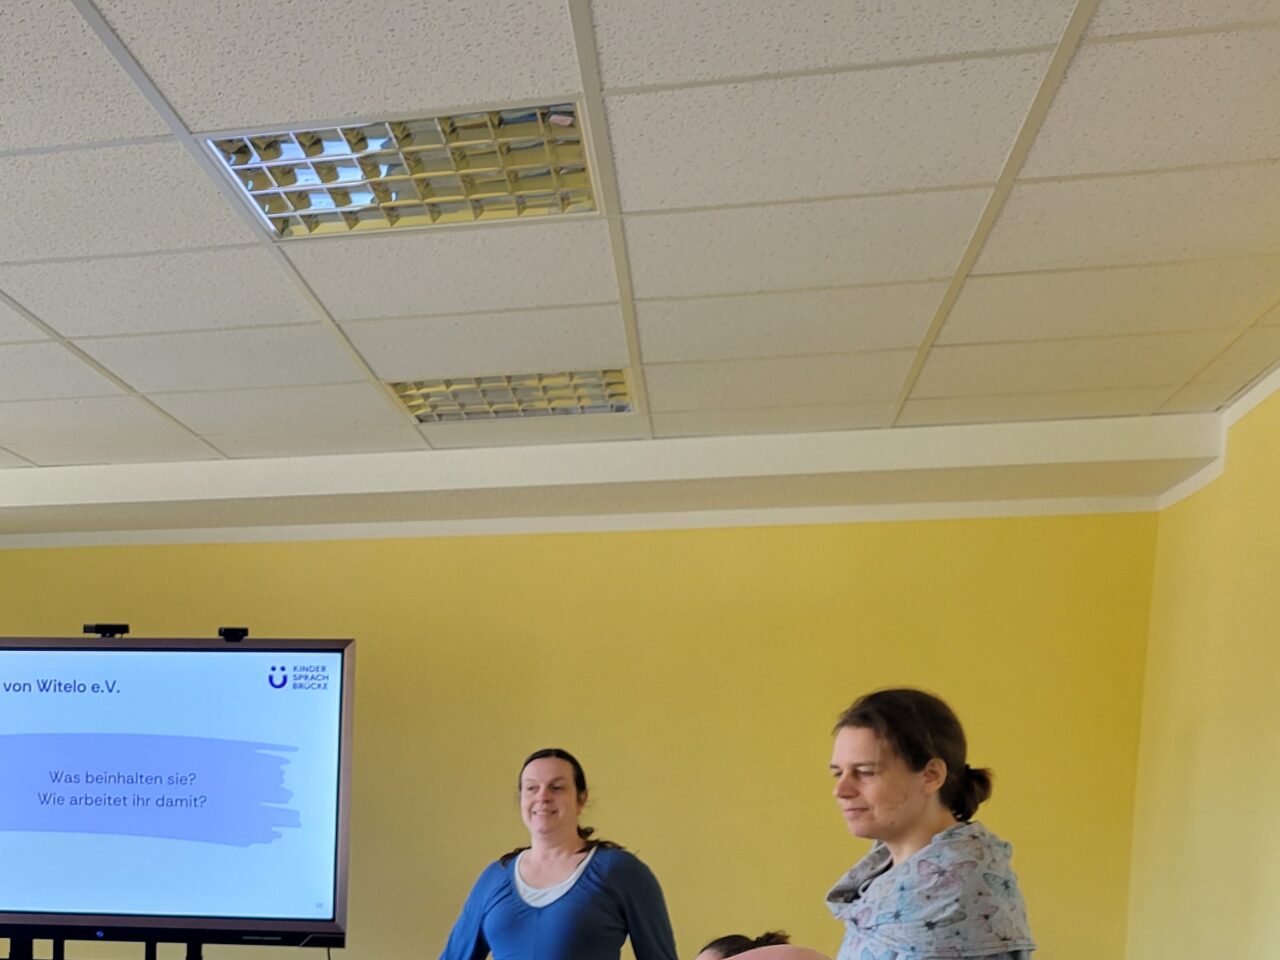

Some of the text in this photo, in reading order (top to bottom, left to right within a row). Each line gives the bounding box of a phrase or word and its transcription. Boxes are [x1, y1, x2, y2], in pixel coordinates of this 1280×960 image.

[293, 664, 327, 672] KINDER
[293, 673, 329, 681] SPRACH
[3, 681, 32, 693] von
[36, 678, 87, 693] Witelo
[91, 679, 121, 694] e.V.
[49, 770, 197, 786] Was beinhalten sie?
[38, 792, 208, 808] Wie arbeitet ihr damit?
